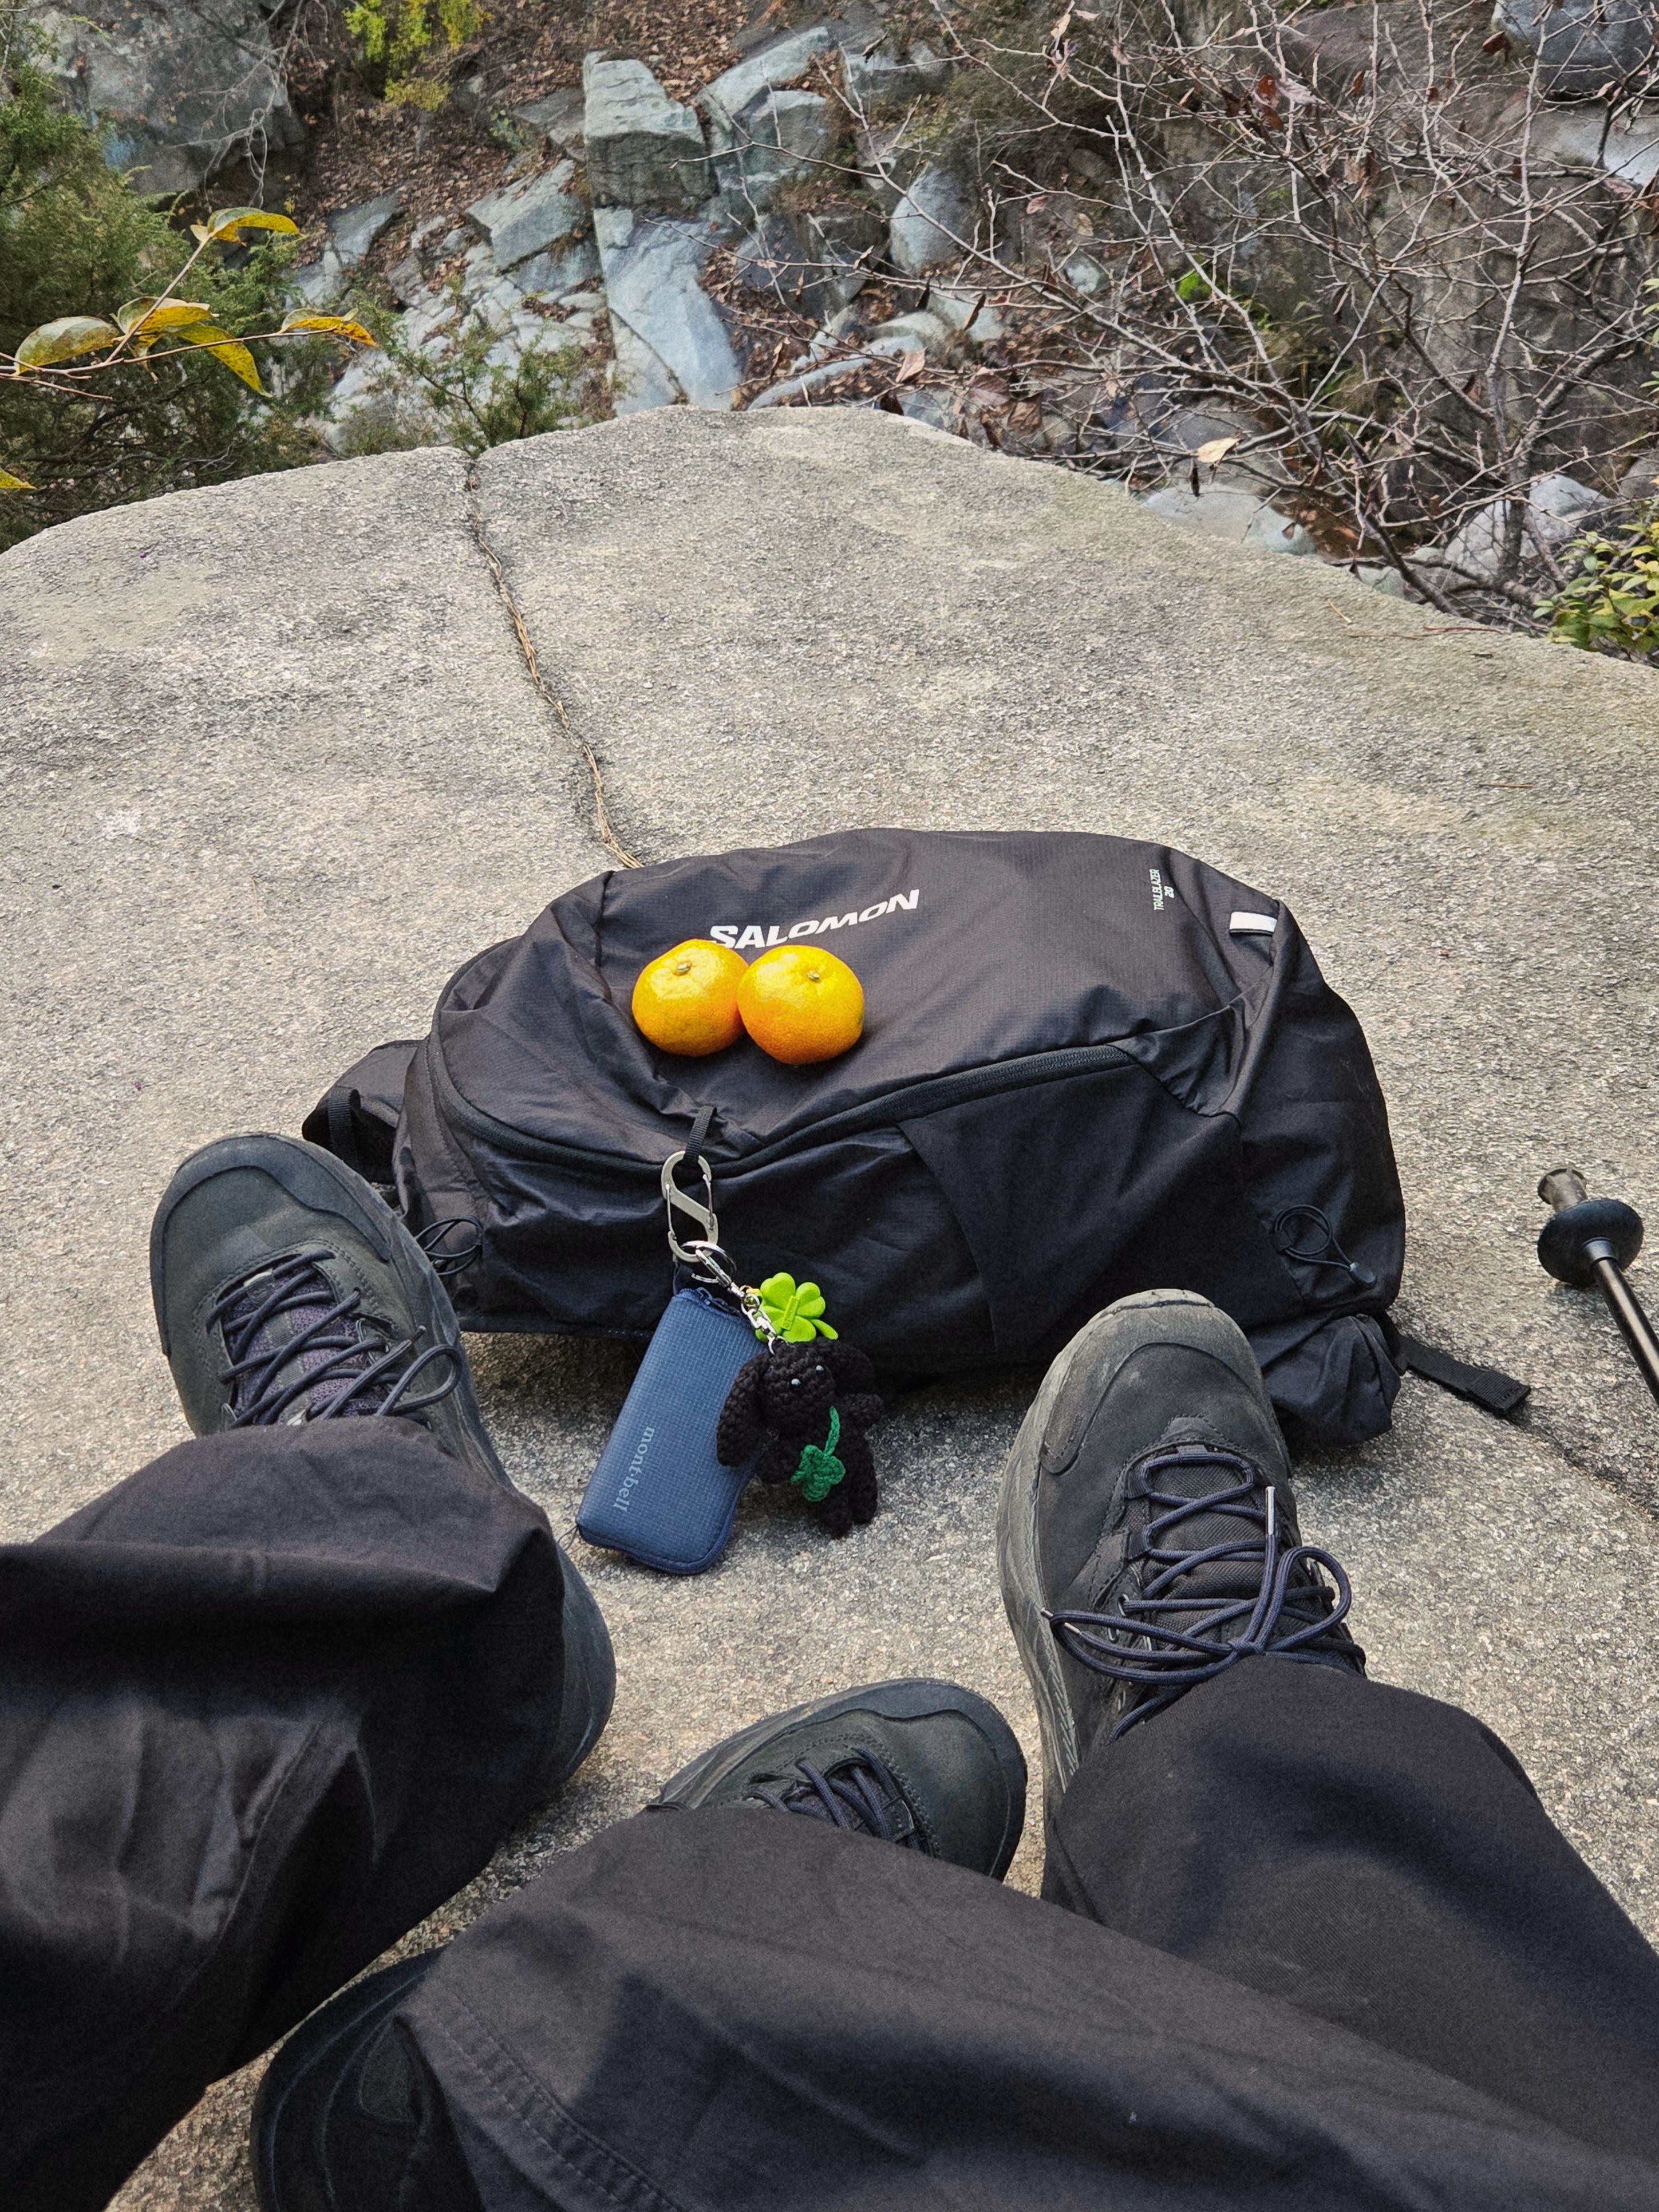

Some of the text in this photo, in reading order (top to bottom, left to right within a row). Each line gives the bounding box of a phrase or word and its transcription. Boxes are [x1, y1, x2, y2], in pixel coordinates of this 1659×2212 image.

[1149, 868, 1164, 911] TRAILBLAZER
[1163, 885, 1175, 899] 20
[710, 888, 919, 949] SALOMON
